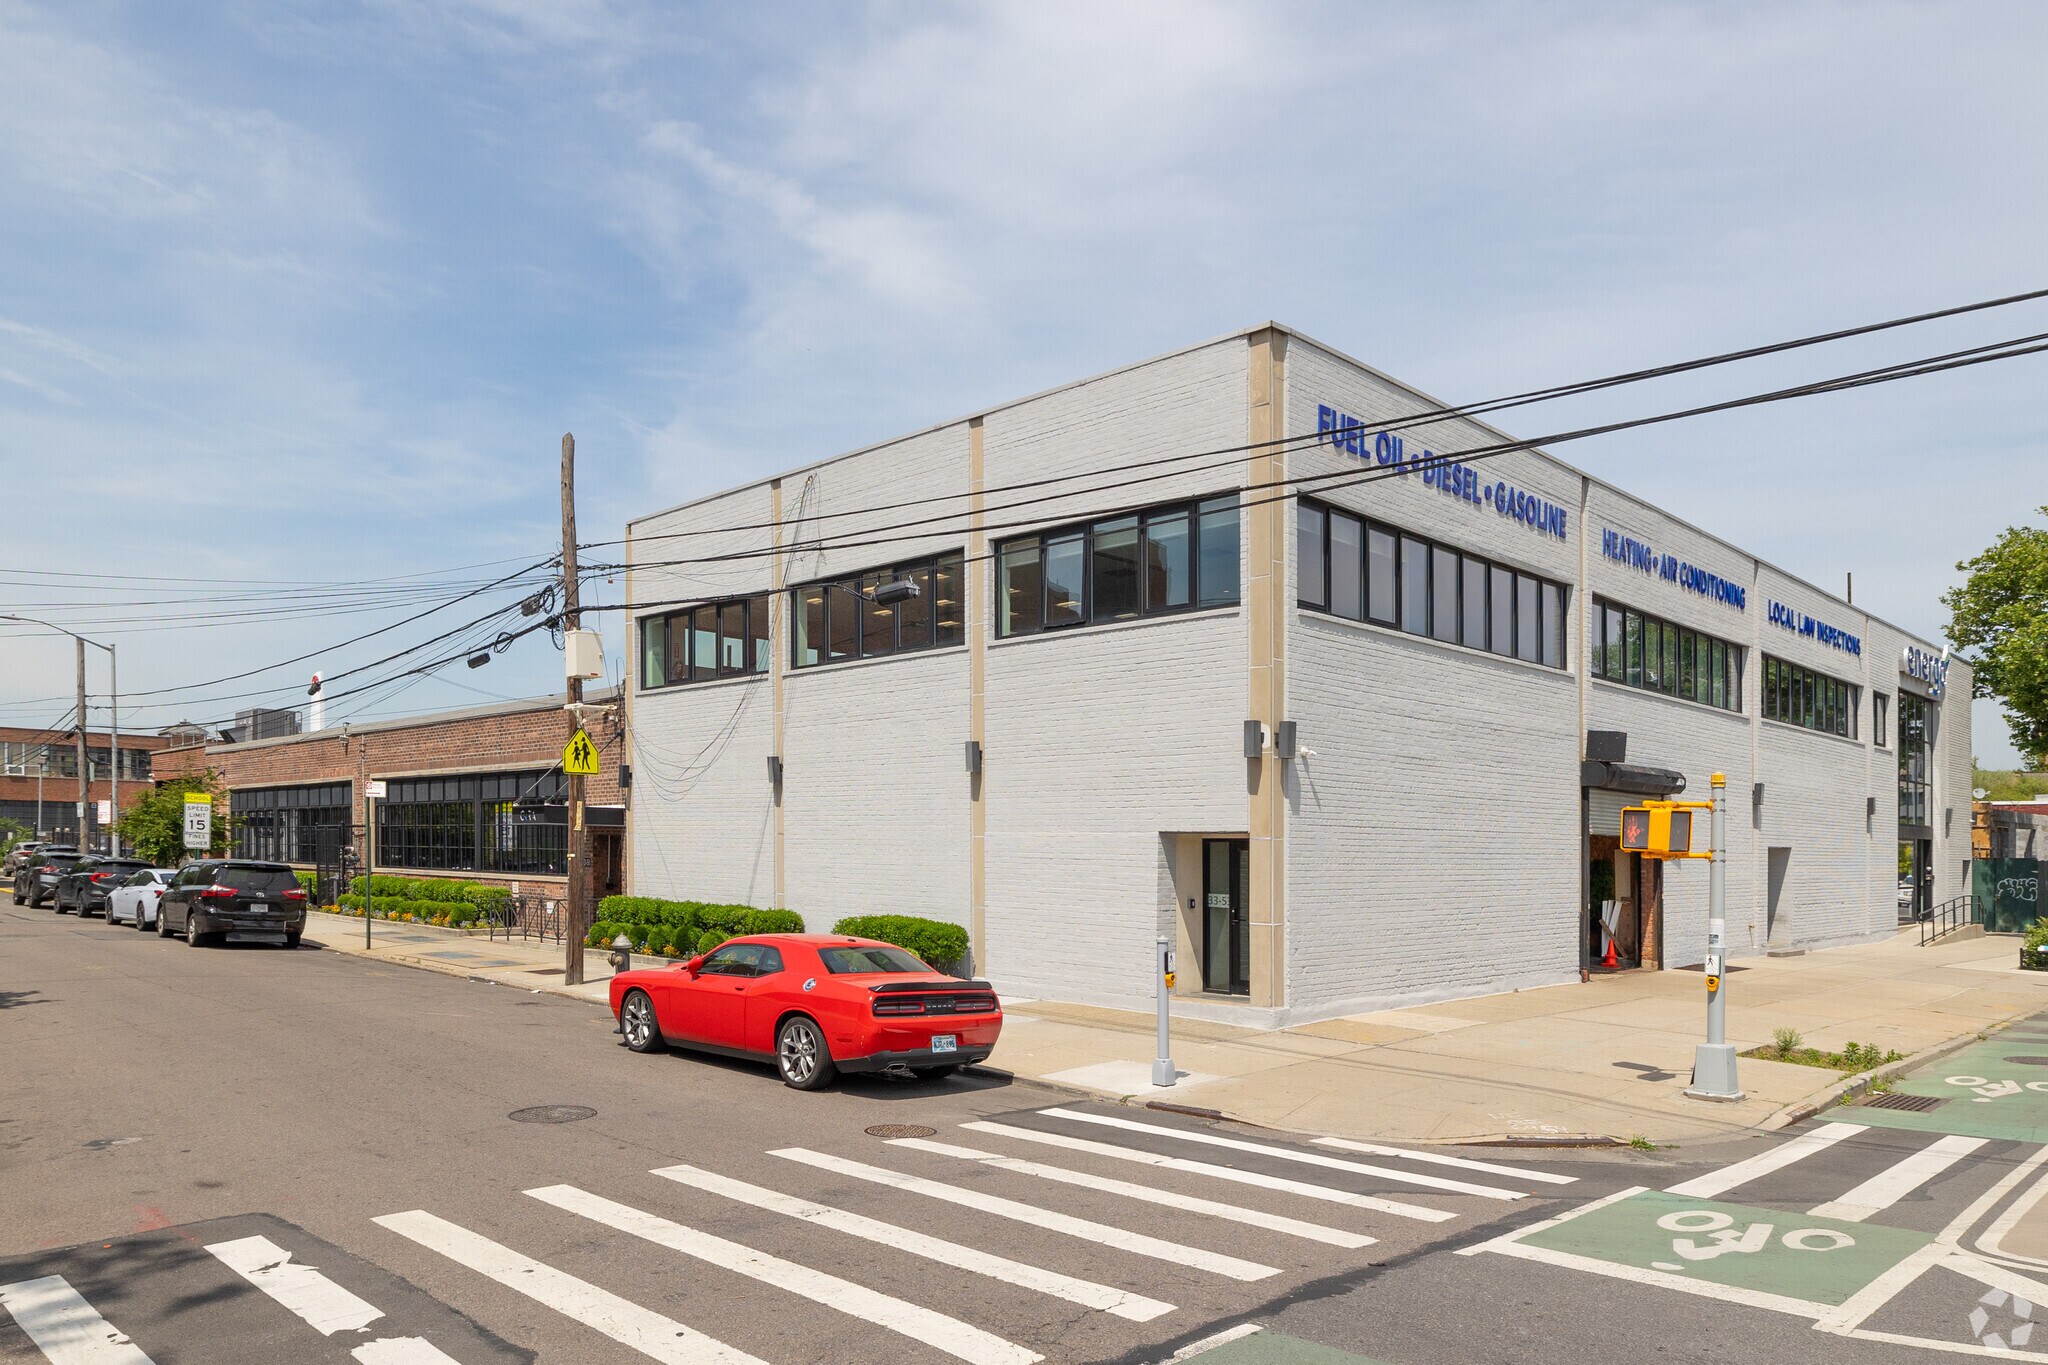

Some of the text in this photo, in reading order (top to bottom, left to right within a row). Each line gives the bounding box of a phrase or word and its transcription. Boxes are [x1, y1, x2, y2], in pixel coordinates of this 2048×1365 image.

[1317, 403, 1567, 539] FUEL OIL DIESEL GASOLINE
[1602, 527, 1746, 610] HEATING AIR CONDITIONING
[1768, 599, 1861, 657] LOCAL LAW INSPECTIONS
[189, 819, 206, 831] 15
